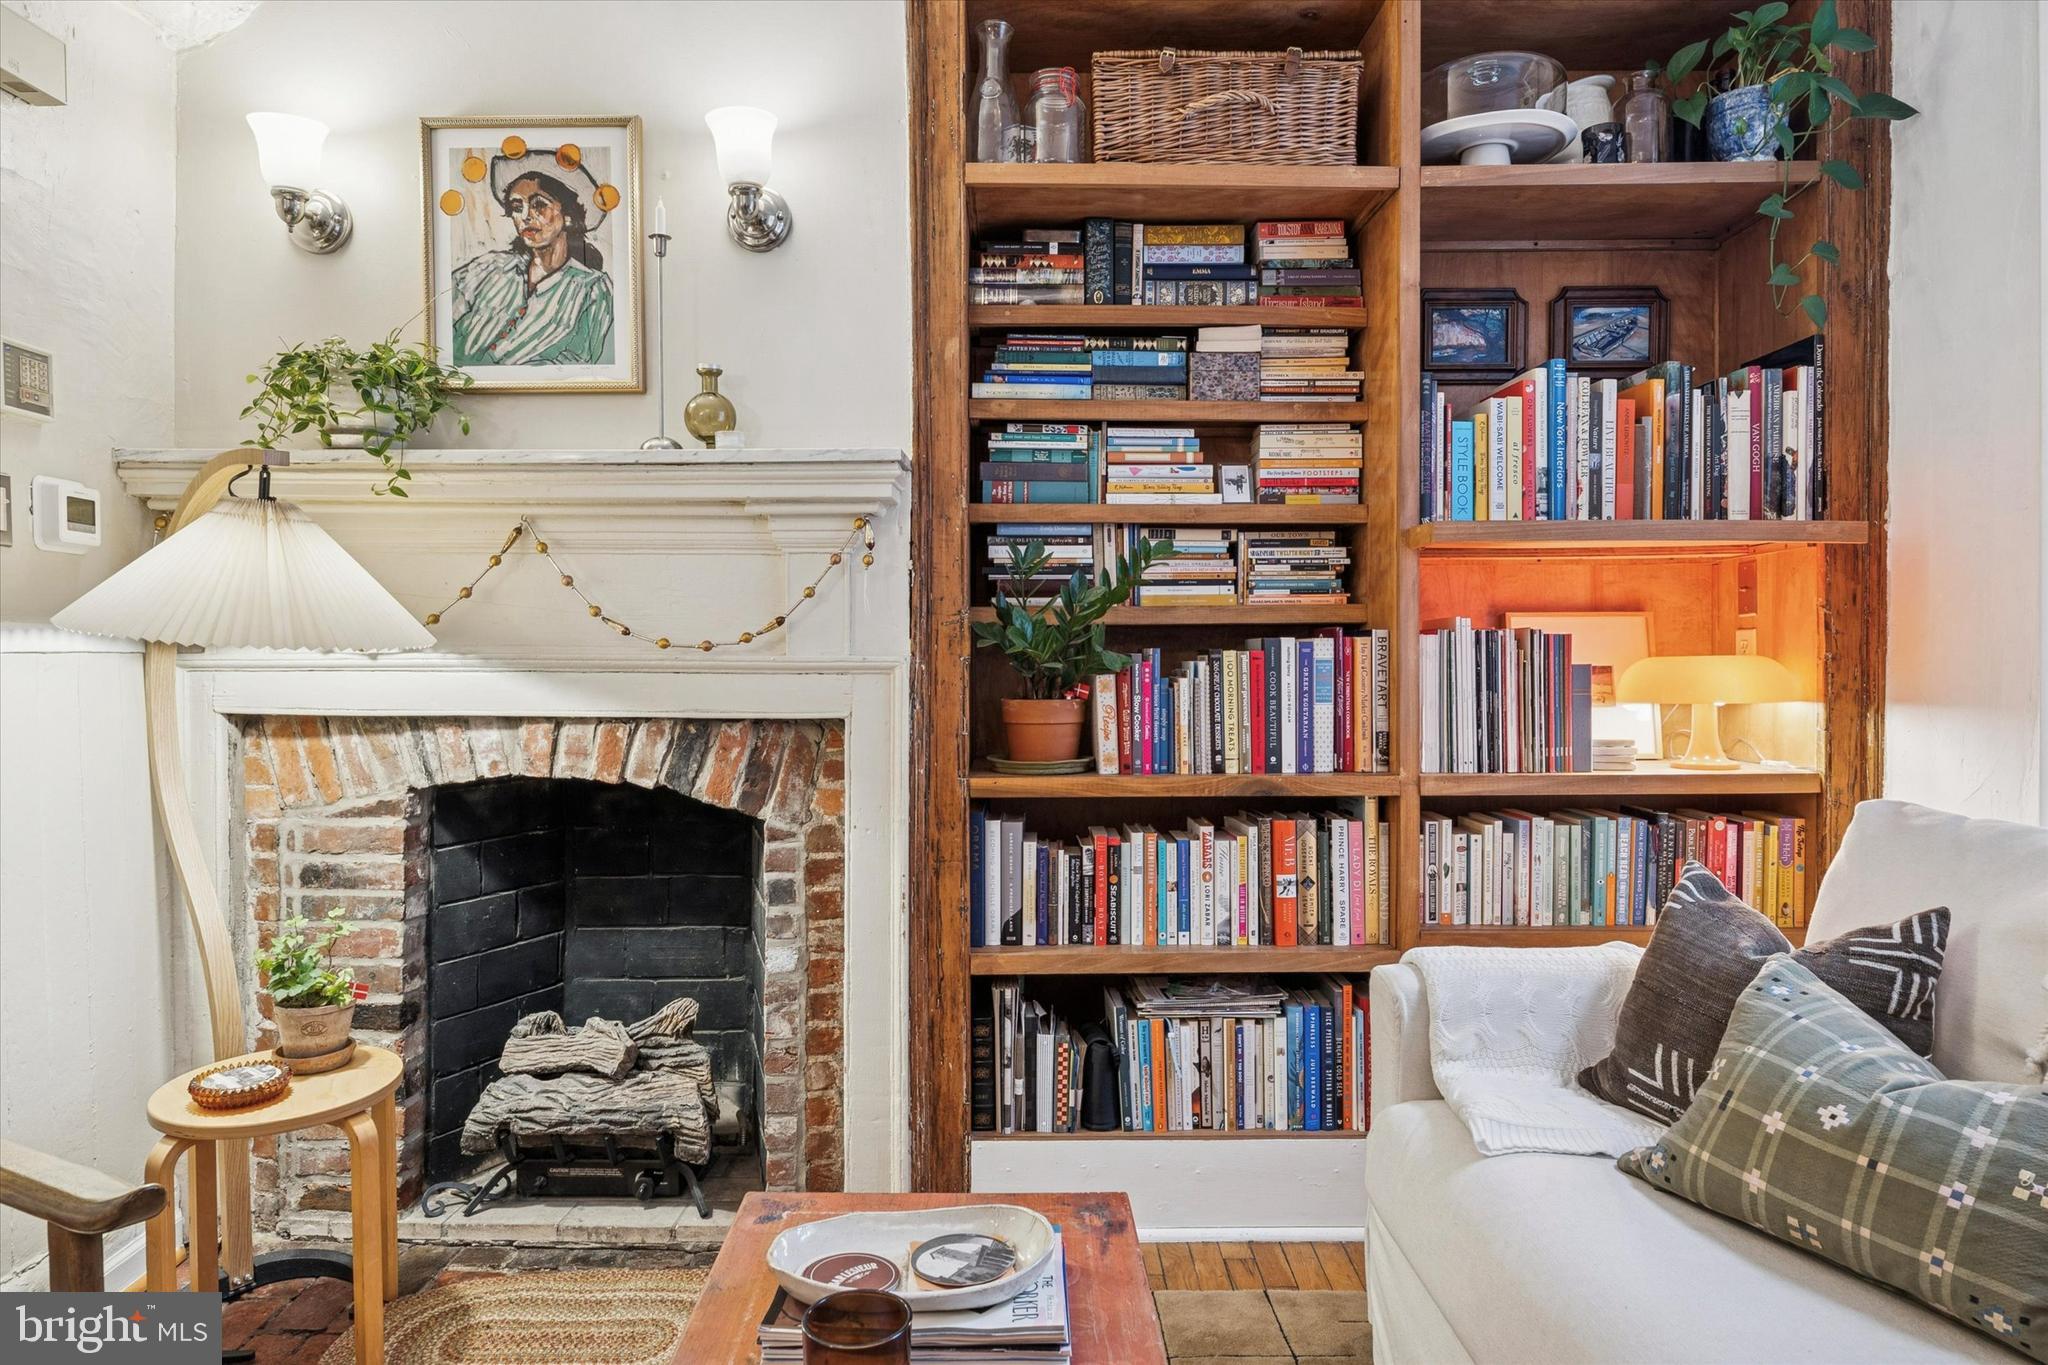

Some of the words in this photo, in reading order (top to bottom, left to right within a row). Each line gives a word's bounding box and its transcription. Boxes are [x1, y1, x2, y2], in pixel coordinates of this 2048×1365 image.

[1261, 297, 1297, 307] Treasure
[1300, 297, 1325, 307] Island
[1528, 398, 1534, 410] ON
[1581, 380, 1589, 426] COLEFAX
[1816, 380, 1824, 411] Colorado
[1556, 401, 1564, 423] New
[1556, 425, 1564, 446] York
[1606, 420, 1614, 444] LIVE
[1752, 423, 1760, 441] VAN
[1772, 425, 1780, 463] PARADISE
[1424, 456, 1430, 465] OF
[1457, 436, 1468, 471] STYLE
[1581, 438, 1589, 478] FOWLER
[1752, 444, 1760, 472] GOGH
[1496, 447, 1504, 491] WELCOME
[1512, 454, 1520, 485] fresco
[1556, 447, 1564, 488] Interiors
[1605, 448, 1614, 506] BEAUTIFUL
[1457, 476, 1468, 514] BOOK
[1360, 670, 1368, 693] Country
[1377, 636, 1387, 709] BRAVETART
[1099, 704, 1116, 742] Recipe
[1797, 825, 1805, 837] The
[1284, 836, 1294, 856] Mr.
[1620, 833, 1628, 858] BEACH
[1781, 843, 1790, 862] Help
[1796, 838, 1804, 858] Setup
[1285, 858, 1295, 868] B
[1353, 880, 1360, 891] DI
[1369, 859, 1377, 894] ROYALS
[1380, 866, 1388, 920] IRELAND
[1042, 1276, 1053, 1288] THE
